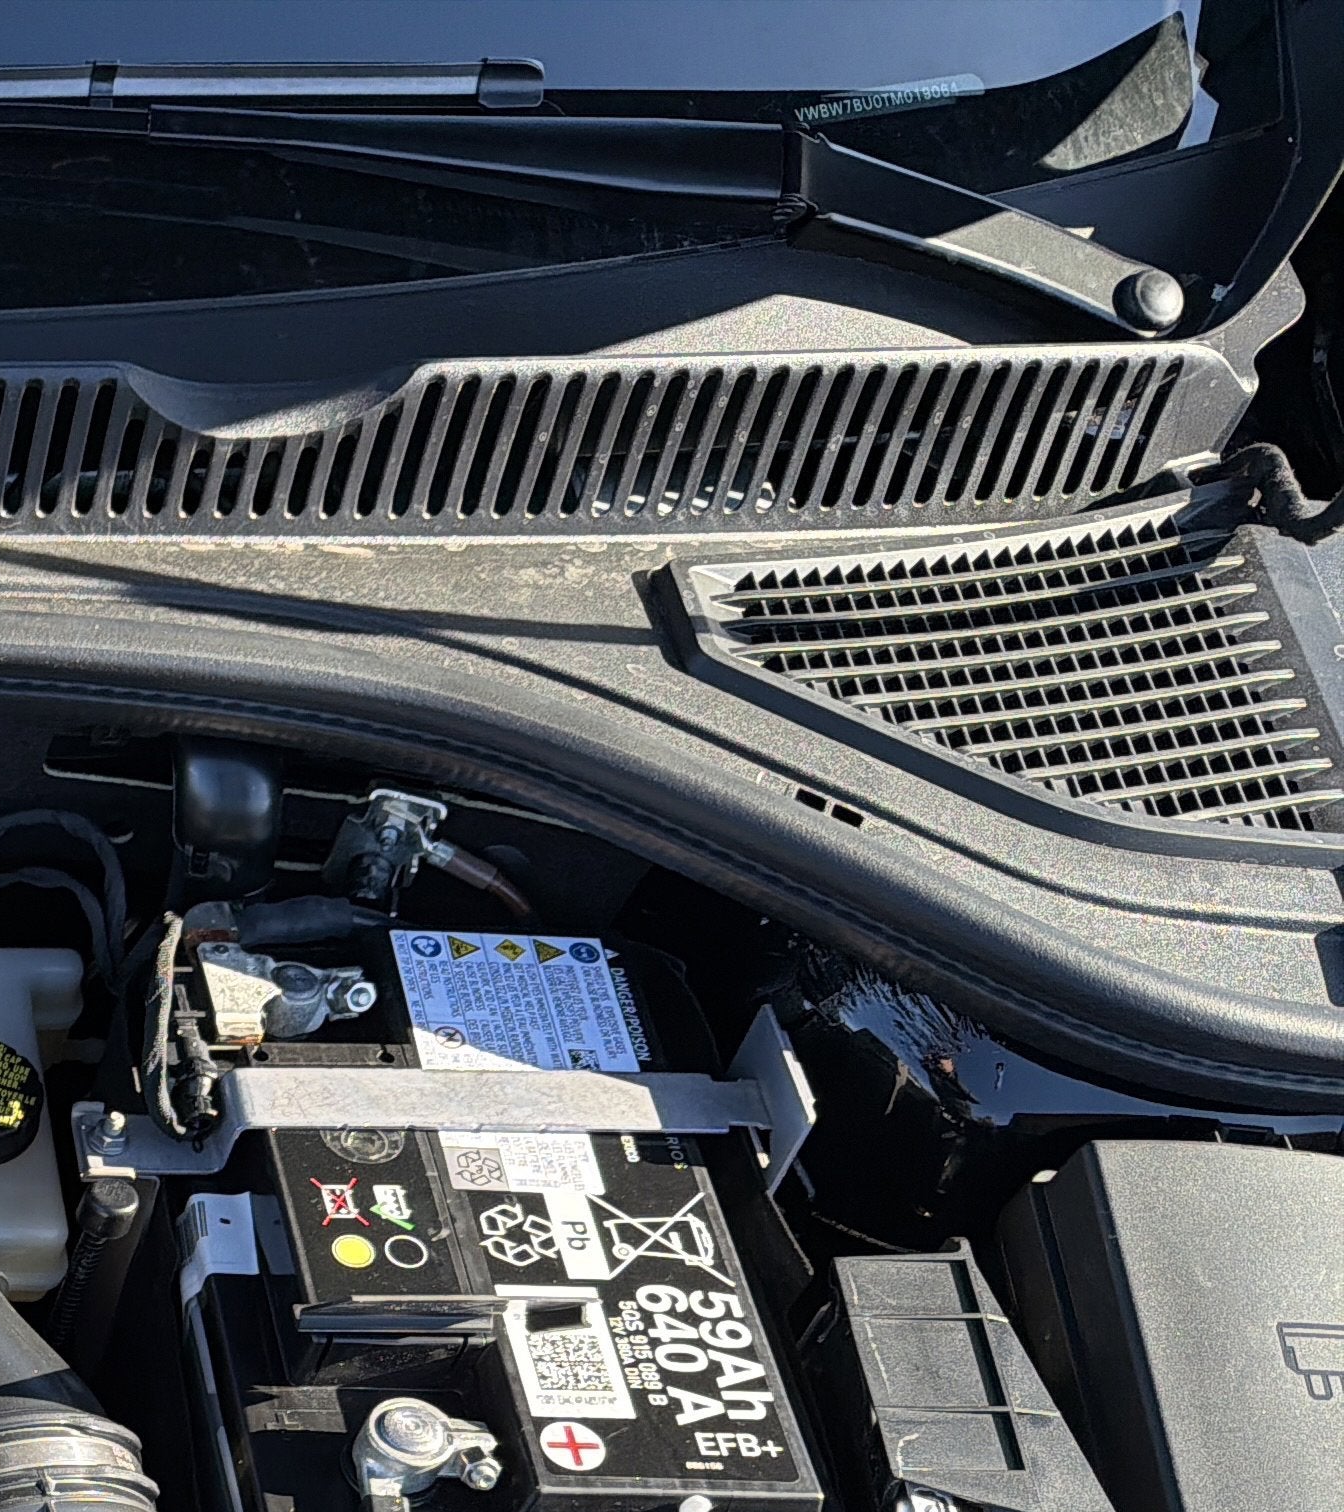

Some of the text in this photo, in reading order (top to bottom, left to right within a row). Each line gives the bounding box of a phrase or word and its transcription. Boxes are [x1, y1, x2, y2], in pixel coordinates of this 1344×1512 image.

[609, 967, 652, 1061] DANGER/POISON
[3, 1053, 22, 1065] CAP
[12, 1063, 30, 1075] USE
[2, 1069, 28, 1083] FROM
[561, 1220, 592, 1252] Pb
[635, 1284, 710, 1374] 640
[607, 1316, 625, 1336] 12V
[624, 1366, 643, 1390] DIN
[629, 1334, 654, 1362] 915
[688, 1288, 775, 1421] 59Ah
[637, 1361, 663, 1391] 089
[649, 1393, 669, 1407] B
[666, 1385, 726, 1427] A
[693, 1431, 784, 1459] EFB+
